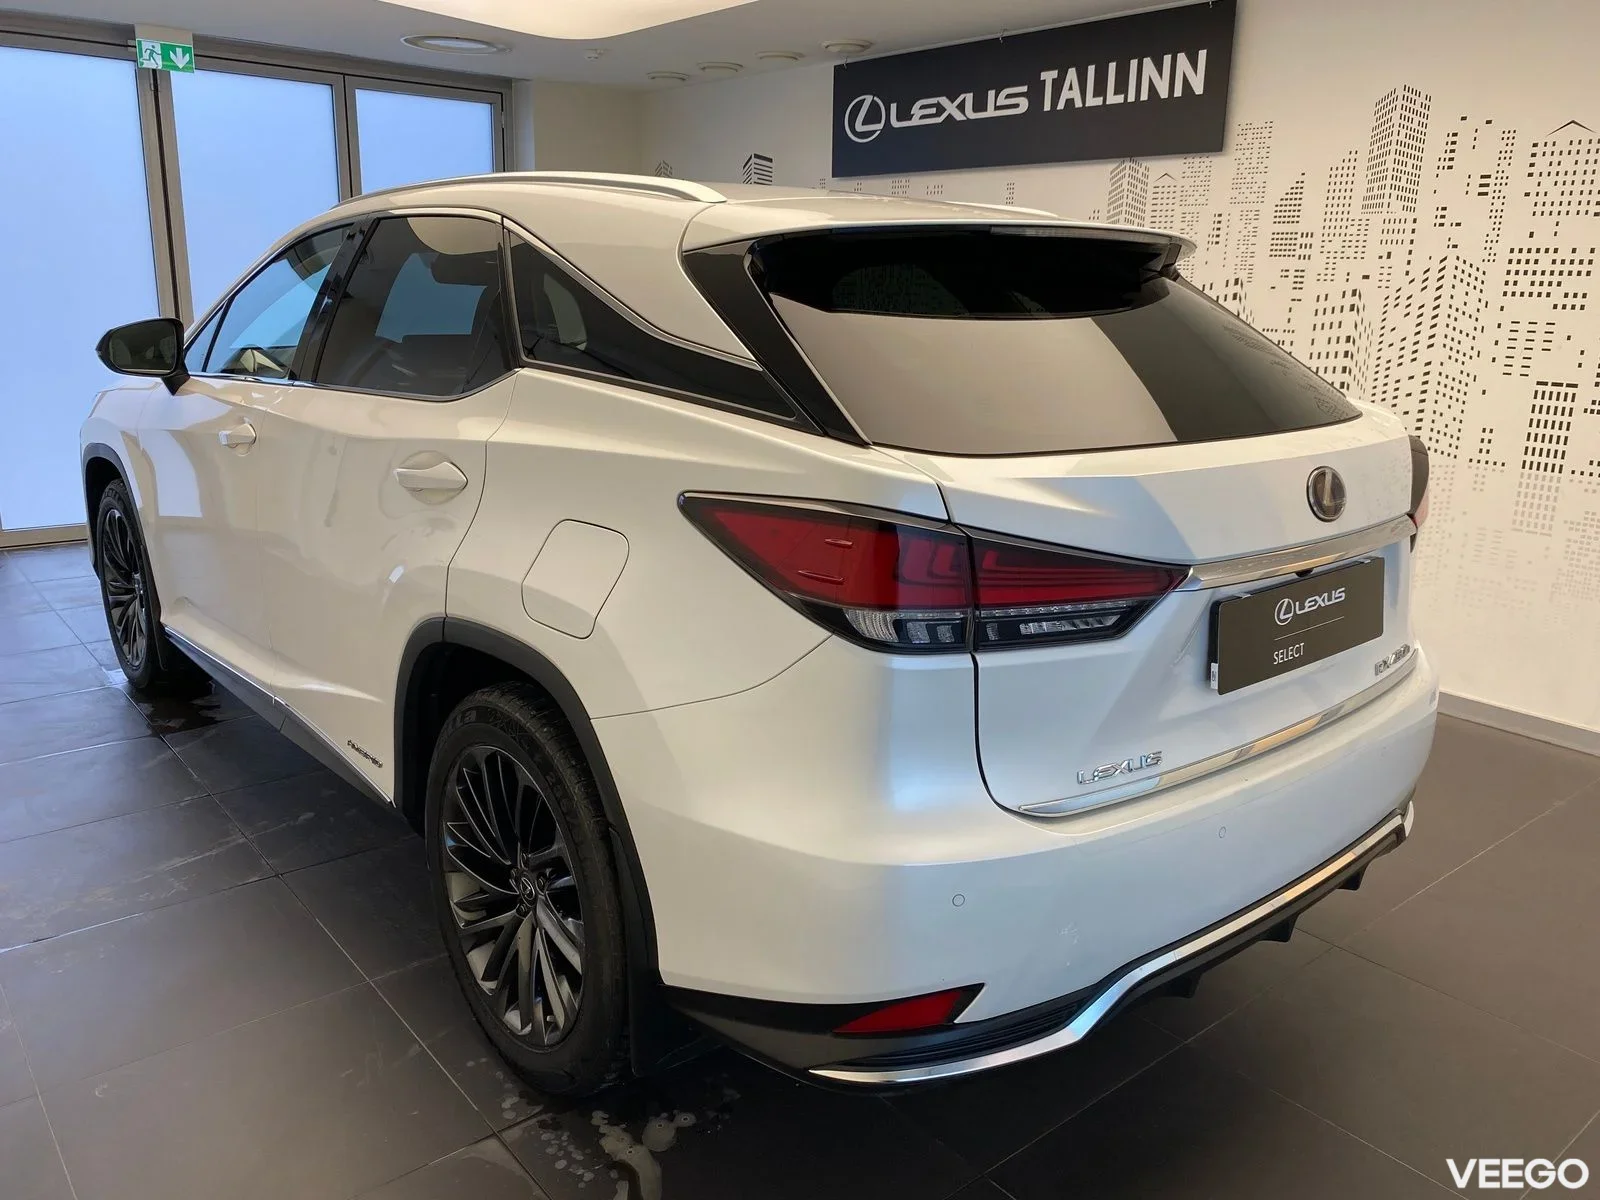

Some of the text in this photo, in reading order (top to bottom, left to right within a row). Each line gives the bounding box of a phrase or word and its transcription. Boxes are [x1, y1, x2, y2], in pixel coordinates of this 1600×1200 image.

[889, 49, 1208, 128] LEXUS TALLINN
[1295, 587, 1346, 614] LEXUS
[1273, 642, 1305, 665] SELECT
[1077, 751, 1162, 784] LEXUS
